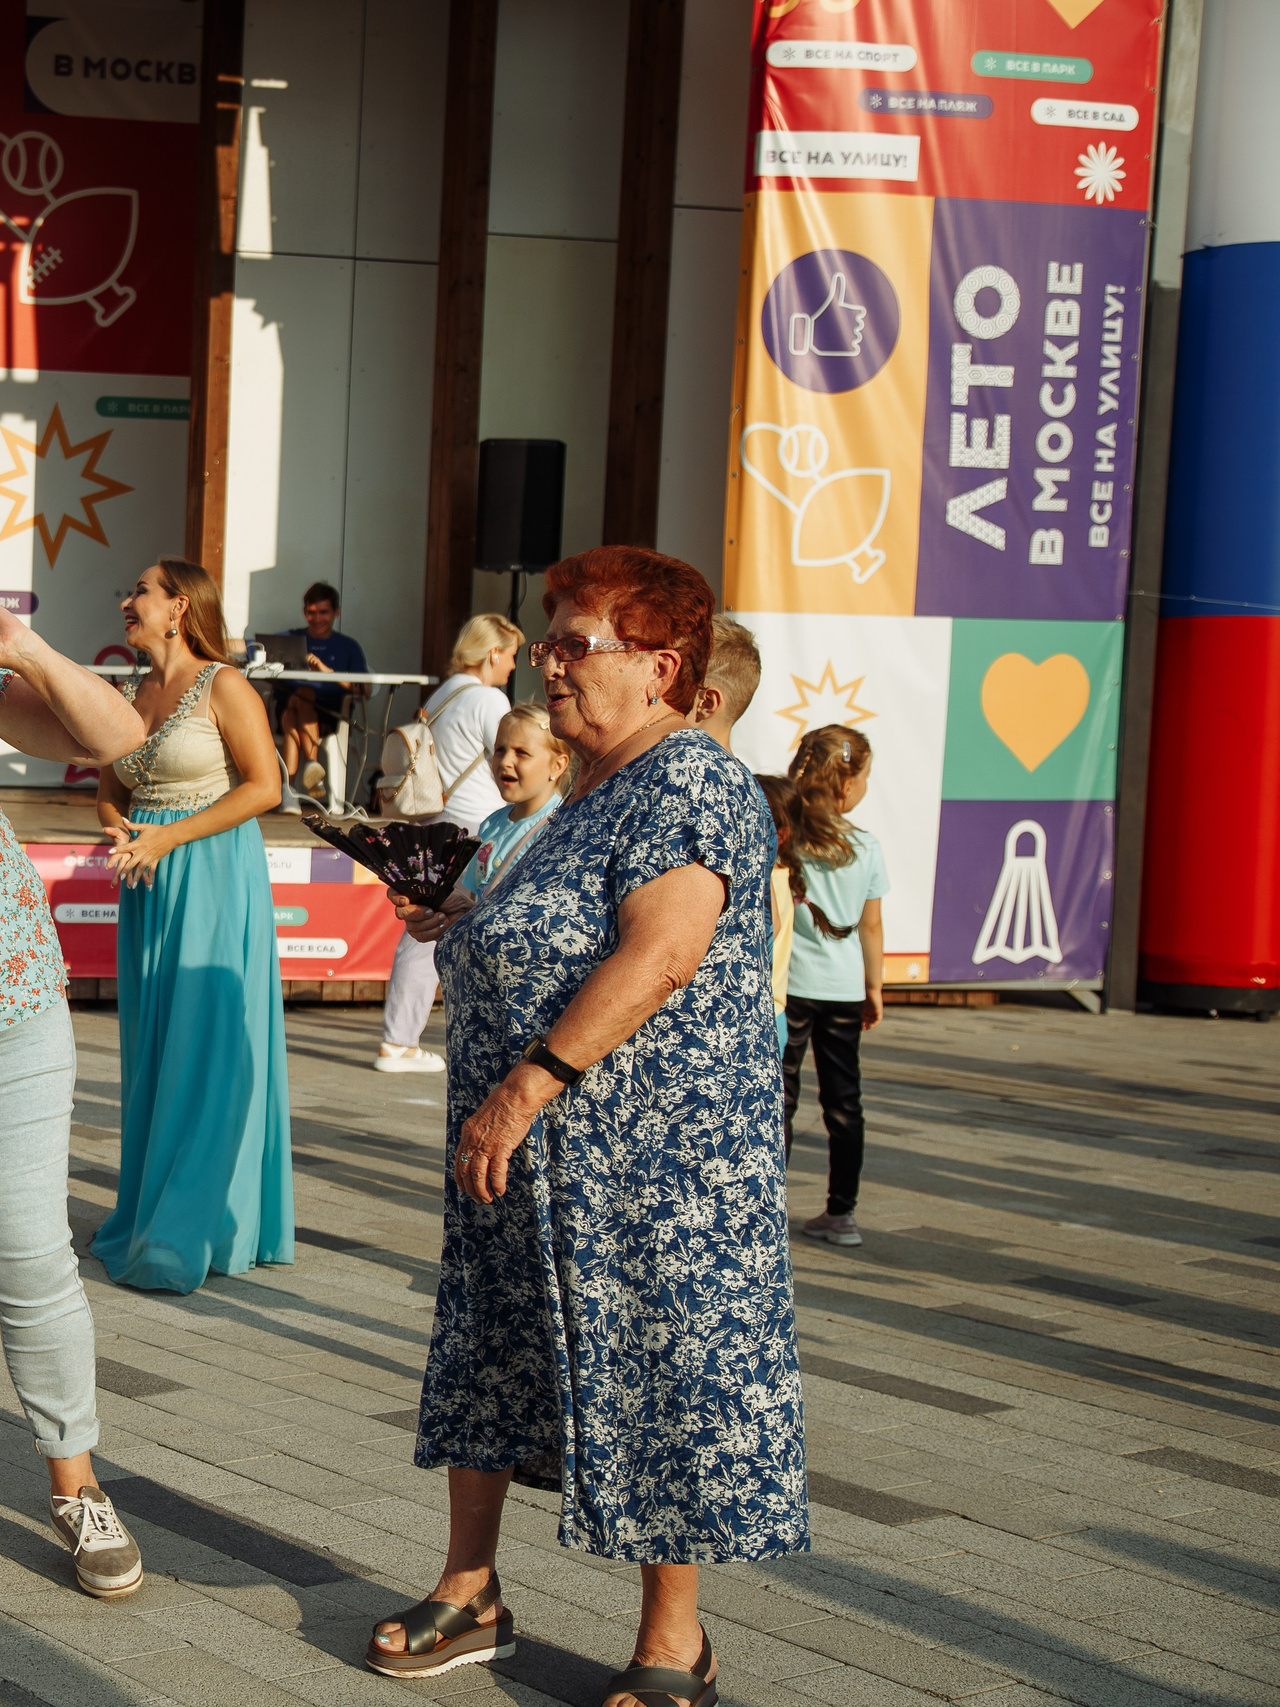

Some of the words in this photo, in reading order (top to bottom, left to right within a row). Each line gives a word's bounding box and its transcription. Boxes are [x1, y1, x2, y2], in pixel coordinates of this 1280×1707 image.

[805, 49, 831, 60] ВСЕ
[834, 49, 853, 60] НА
[857, 50, 900, 63] СПОРТ
[54, 54, 73, 77] В
[1005, 59, 1030, 72] ВСЕ
[1031, 61, 1040, 73] В
[1041, 62, 1076, 76] ПАРК
[888, 96, 916, 110] ВСЕ
[917, 98, 937, 111] НА
[938, 98, 978, 113] ПЛЯЖ
[1068, 108, 1089, 120] ВСЕ
[1092, 110, 1100, 121] В
[1103, 111, 1125, 123] САД
[766, 150, 801, 164] ВСЕ
[807, 151, 835, 165] НА
[841, 152, 908, 168] УЛИЦУ!
[1097, 283, 1126, 416] УЛИЦУ!
[1031, 260, 1083, 512] МОСКВЕ
[128, 403, 150, 413] ВСЕ
[945, 264, 1021, 551] ЛЕТО
[1093, 422, 1117, 473] НА
[1088, 480, 1114, 548] ВСЕ
[1028, 528, 1064, 565] В
[81, 910, 100, 918] ВСЕ
[103, 910, 117, 918] НА
[317, 945, 336, 953] САД
